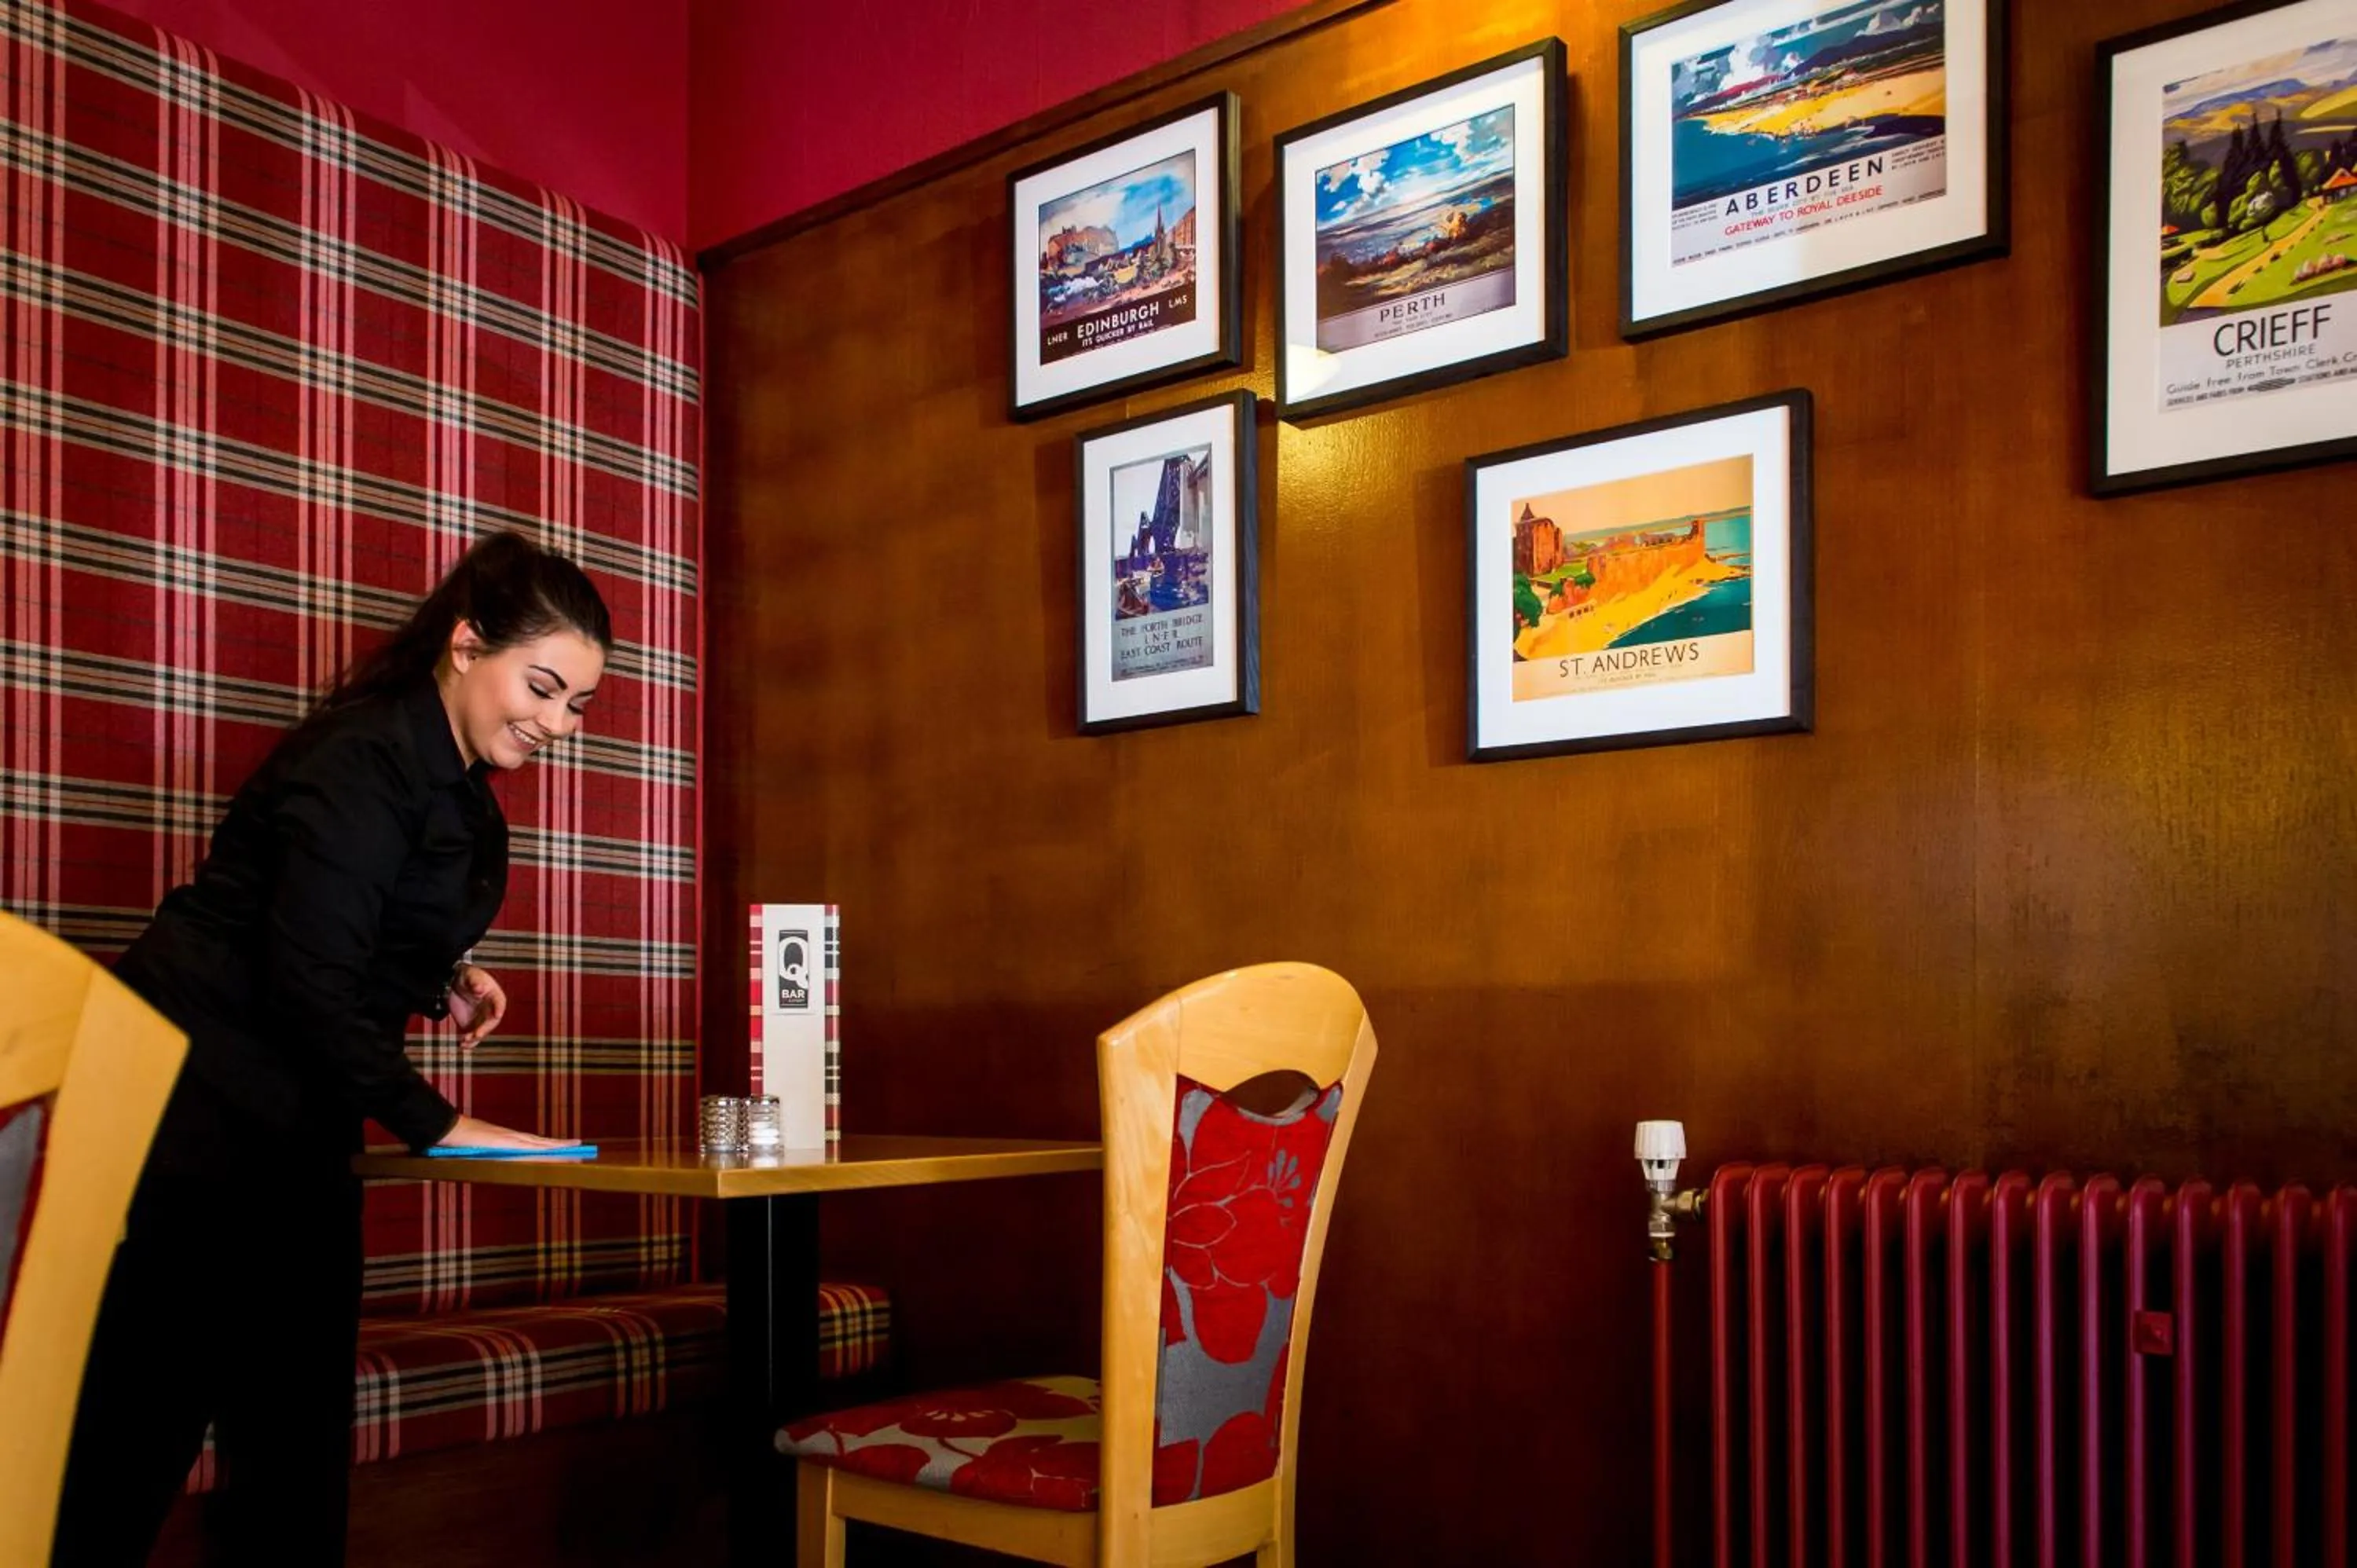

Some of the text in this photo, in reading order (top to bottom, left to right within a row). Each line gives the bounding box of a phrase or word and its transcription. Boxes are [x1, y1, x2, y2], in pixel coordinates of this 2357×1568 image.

[1725, 156, 1883, 216] ABERDEEN
[1725, 214, 1776, 236] GATEWAY
[1780, 210, 1794, 222] TO
[1797, 201, 1832, 218] ROYAL
[1835, 185, 1883, 207] DEESIDE
[1077, 301, 1159, 339] EDINBURGH
[1380, 293, 1446, 323] PERTH
[1095, 328, 1124, 344] QUICKER
[2213, 303, 2332, 357] CRIEFF
[2225, 343, 2317, 369] PERTHSHIRE
[2166, 381, 2200, 394] Guide
[2269, 365, 2300, 376] Town
[1172, 614, 1202, 627] BRIDGE
[1120, 636, 1203, 660] EAST COAST ROUTE
[1560, 658, 1586, 678] ST.
[1593, 642, 1699, 674] ANDREWS
[779, 936, 808, 988] Q
[782, 989, 805, 998] BAR
